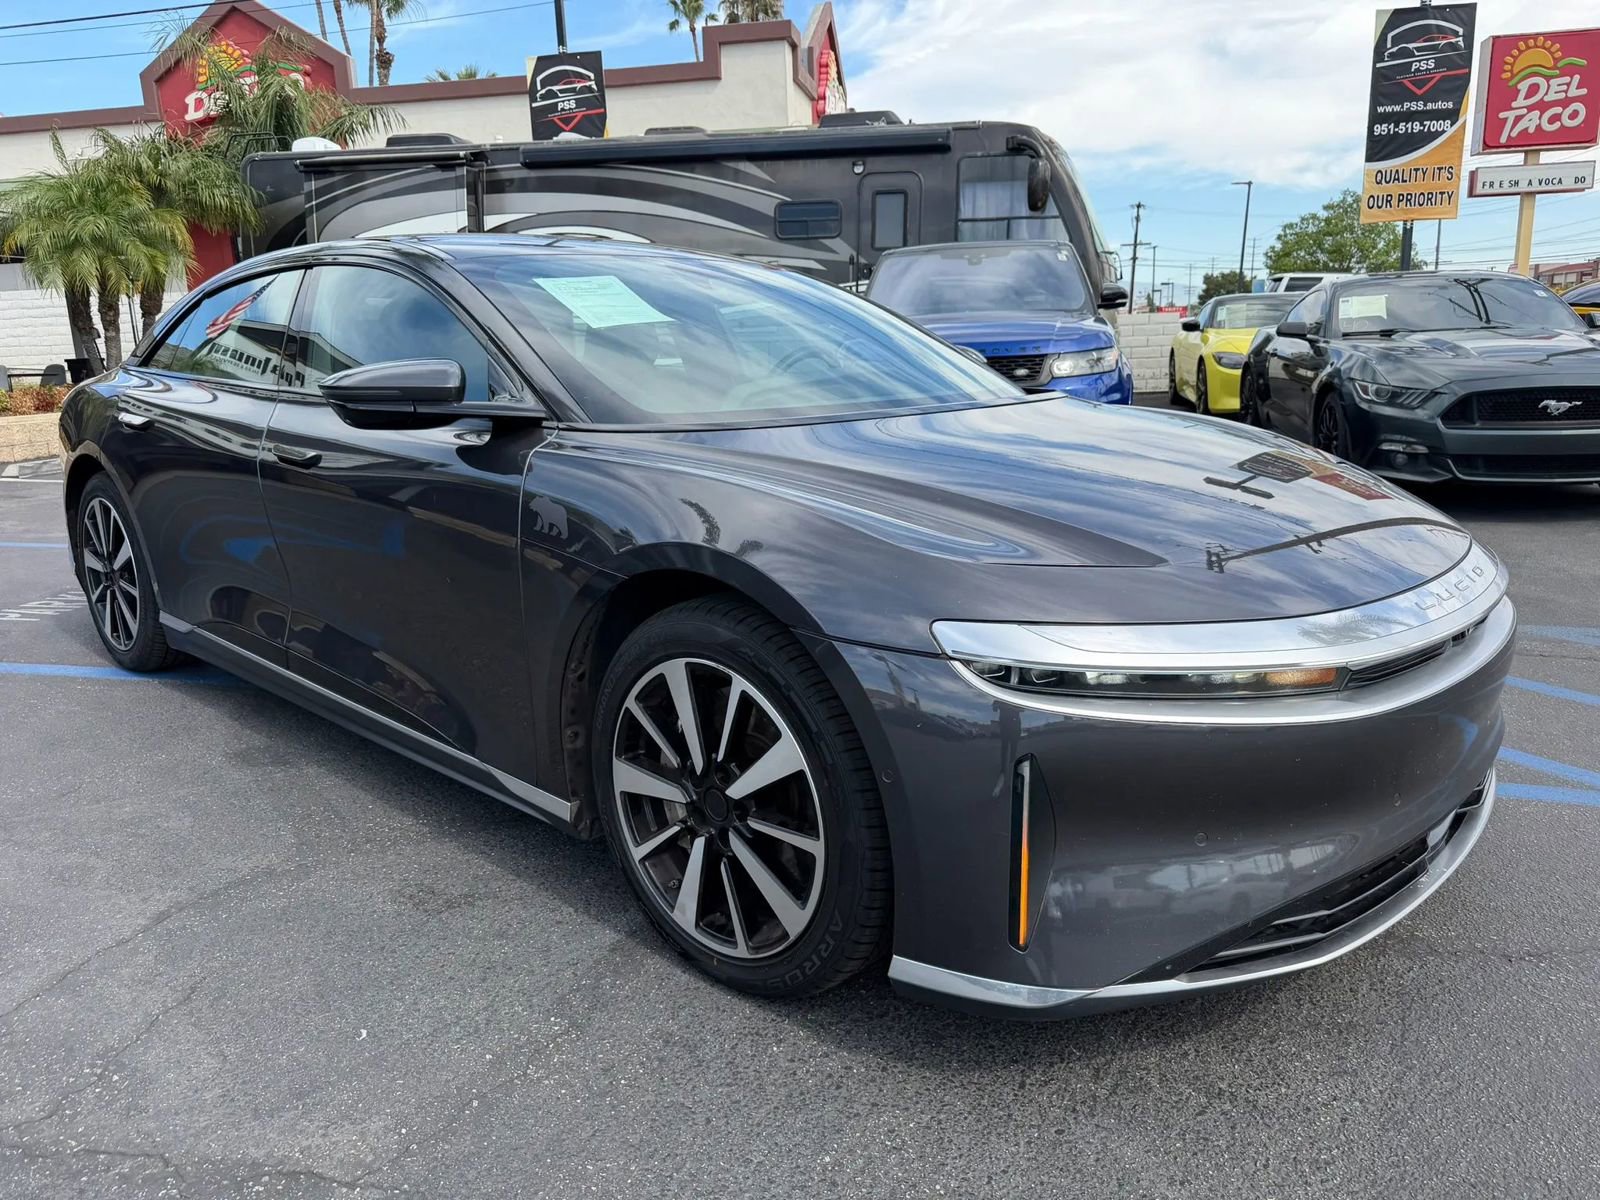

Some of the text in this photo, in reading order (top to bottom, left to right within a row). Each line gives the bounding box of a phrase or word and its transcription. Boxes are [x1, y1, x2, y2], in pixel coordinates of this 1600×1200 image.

[1411, 59, 1436, 72] PSS
[1511, 74, 1588, 108] DEL
[557, 99, 577, 111] PSS
[1377, 100, 1454, 113] www.PSS.autos
[1373, 119, 1451, 136] 951-519-7008
[1498, 102, 1587, 144] TACO
[1375, 165, 1454, 185] QUALITY IT'S
[1481, 179, 1520, 189] FRESH
[1367, 190, 1455, 210] OUR PRIORITY
[1414, 565, 1485, 611] LUCID
